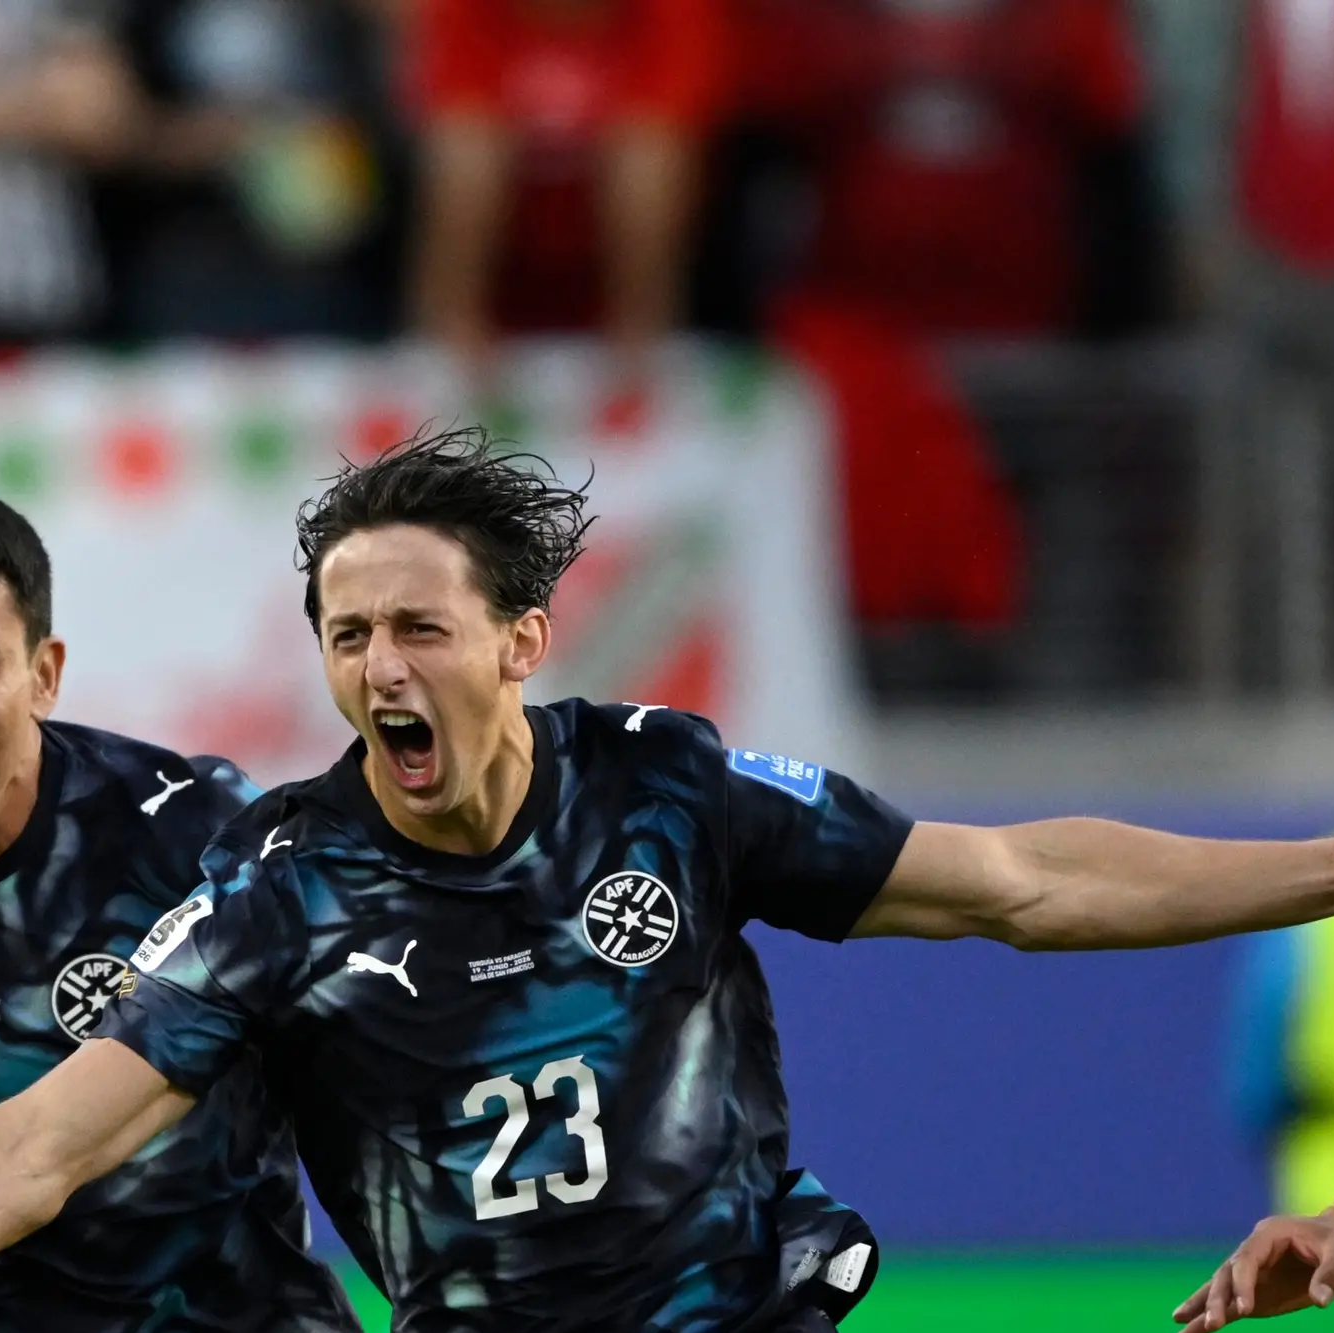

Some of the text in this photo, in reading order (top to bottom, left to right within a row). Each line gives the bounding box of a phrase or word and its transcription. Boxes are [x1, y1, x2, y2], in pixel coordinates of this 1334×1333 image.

[605, 877, 635, 901] APF
[503, 949, 532, 962] PARAGUAY
[620, 940, 663, 961] PARAGUAY
[81, 962, 113, 978] APF
[472, 967, 481, 975] 19
[486, 962, 509, 972] JUNIO
[513, 956, 532, 966] 2026
[494, 970, 506, 978] SAN
[506, 961, 535, 975] FRANCISCO
[462, 1055, 608, 1221] 23
